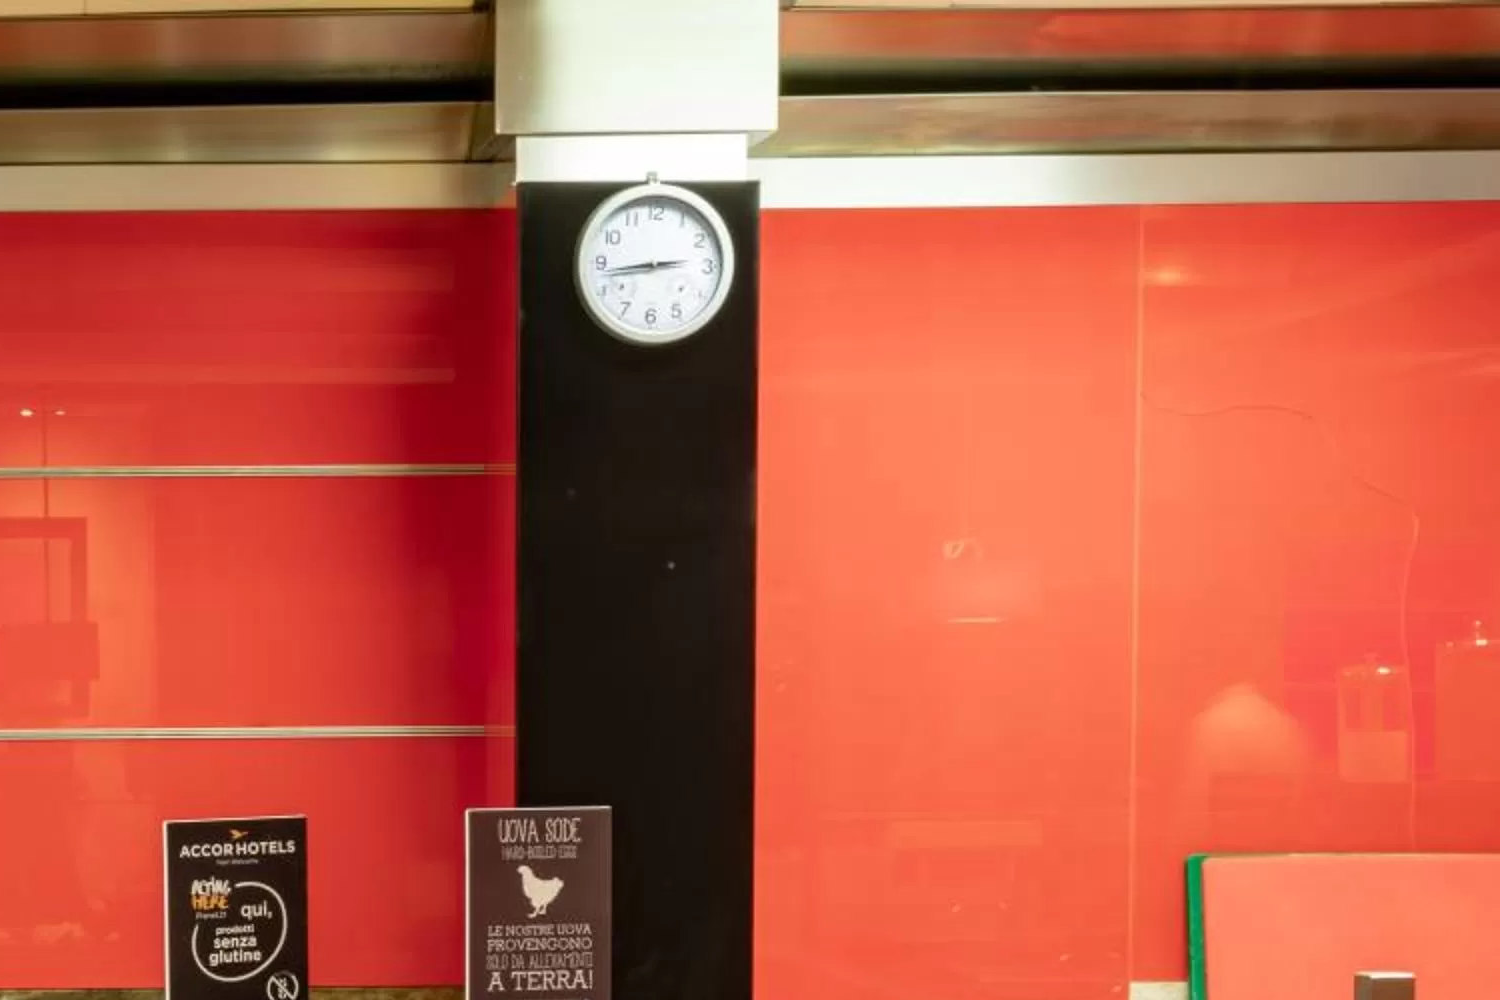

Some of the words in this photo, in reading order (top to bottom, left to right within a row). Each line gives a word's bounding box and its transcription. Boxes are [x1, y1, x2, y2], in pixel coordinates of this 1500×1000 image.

[625, 211, 639, 227] 11
[649, 207, 665, 222] 12
[605, 229, 621, 245] 10
[693, 232, 706, 249] 2
[595, 255, 607, 271] 9
[701, 258, 714, 275] 3
[619, 300, 632, 320] 7
[644, 307, 657, 325] 6
[671, 303, 683, 319] 5
[498, 817, 540, 844] UOVA
[545, 816, 582, 844] SODE
[240, 900, 274, 921] qui,
[487, 925, 503, 937] LE
[505, 924, 556, 937] NOSTRE
[557, 923, 593, 936] UOVA
[213, 935, 257, 950] senza
[486, 937, 594, 953] PROVENGONO
[209, 948, 262, 968] glutine
[487, 971, 505, 993] A
[510, 969, 594, 992] TERRA!
